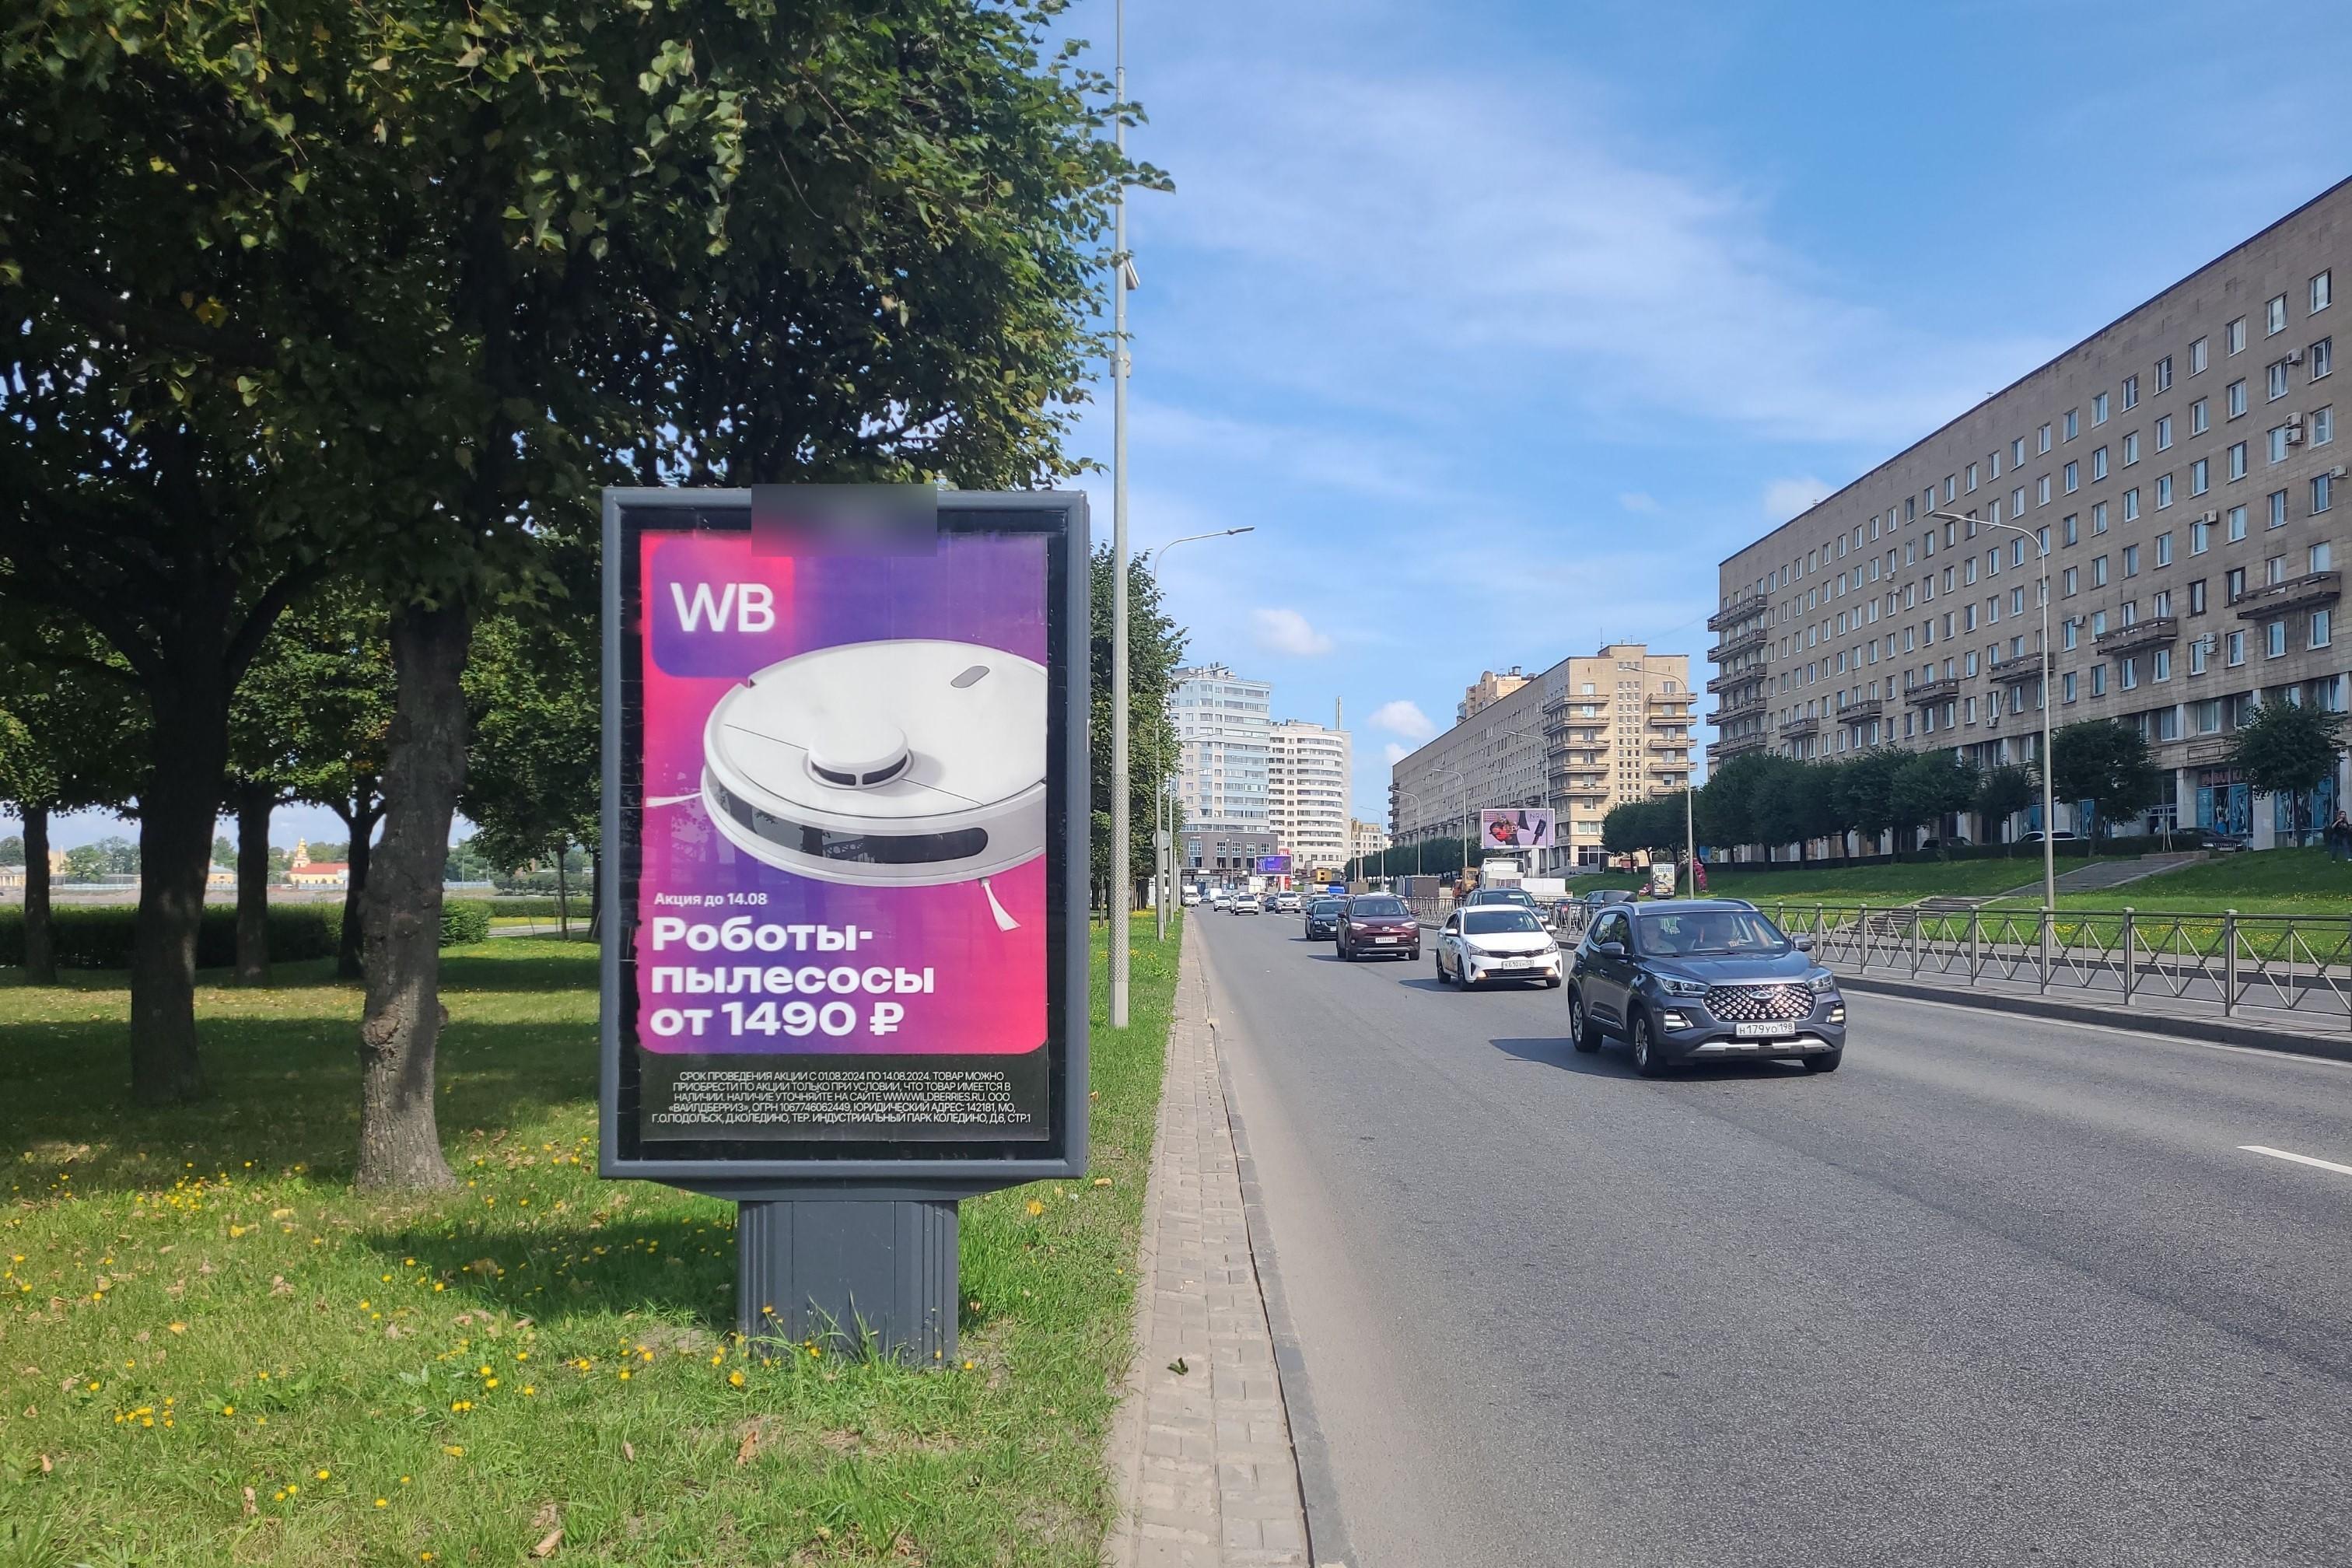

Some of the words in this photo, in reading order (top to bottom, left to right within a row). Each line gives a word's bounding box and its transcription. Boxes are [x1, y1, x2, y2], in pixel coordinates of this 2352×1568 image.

[670, 583, 776, 632] WB
[654, 893, 701, 907] Акция
[704, 896, 723, 907] до
[727, 893, 768, 905] 14.08
[652, 915, 873, 951] Роботы-
[652, 967, 934, 993] пылесосы
[650, 1009, 712, 1036] от
[721, 1002, 856, 1037] 1490
[679, 1072, 706, 1080] СРОК
[708, 1072, 772, 1082] ПРОВЕДЕНИЯ
[774, 1072, 807, 1082] АКЦИИ
[809, 1072, 817, 1080] С
[818, 1072, 865, 1080] 01.08.2024
[866, 1072, 881, 1080] ПО
[883, 1072, 931, 1080] 14.08.2024.
[933, 1072, 964, 1080] ТОВАР
[965, 1072, 1004, 1080] МОЖНО
[755, 1083, 789, 1092] АКЦИИ
[853, 1083, 901, 1092] УСЛОВИИ,
[674, 1093, 725, 1101] НАЛИЧИИ.
[726, 1093, 774, 1101] НАЛИЧИЕ
[775, 1090, 832, 1101] УТОЧНЯЙТЕ
[835, 1093, 848, 1101] НА
[849, 1090, 881, 1101] САЙТЕ
[988, 1093, 1010, 1101] ООО
[752, 1103, 778, 1111] ОГРН
[779, 1103, 852, 1113] 1067746062449,
[854, 1101, 929, 1113] ЮРИДИЧЕСКИЙ
[931, 1103, 964, 1113] АДРЕС:
[966, 1103, 996, 1113] 142181,
[998, 1103, 1016, 1113] МО,
[792, 1114, 811, 1122] ТЕР.
[812, 1111, 905, 1124] ИНДУСТРИАЛЬНЫЙ
[907, 1114, 932, 1122] ПАРК
[933, 1114, 988, 1124] КОЛЕДИНО,
